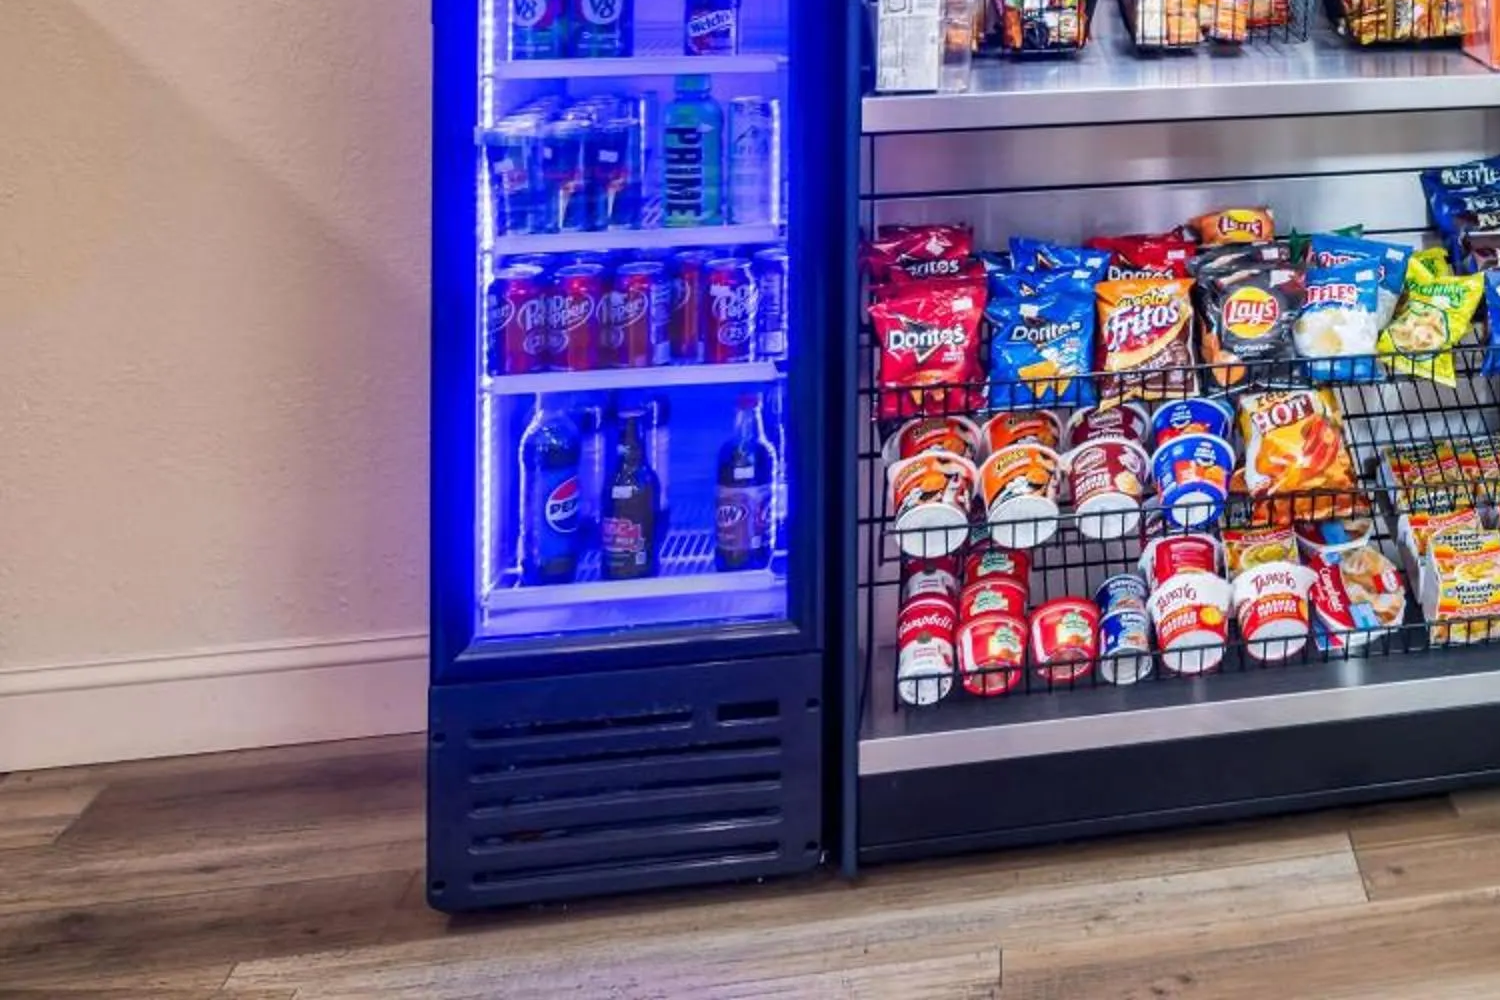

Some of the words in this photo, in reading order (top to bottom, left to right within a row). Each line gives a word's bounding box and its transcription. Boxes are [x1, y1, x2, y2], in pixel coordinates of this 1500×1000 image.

[665, 127, 703, 217] PRIME
[888, 323, 966, 349] Doritos
[1010, 320, 1081, 343] Doritos
[1106, 299, 1181, 352] Fritos
[1253, 396, 1312, 434] HOT
